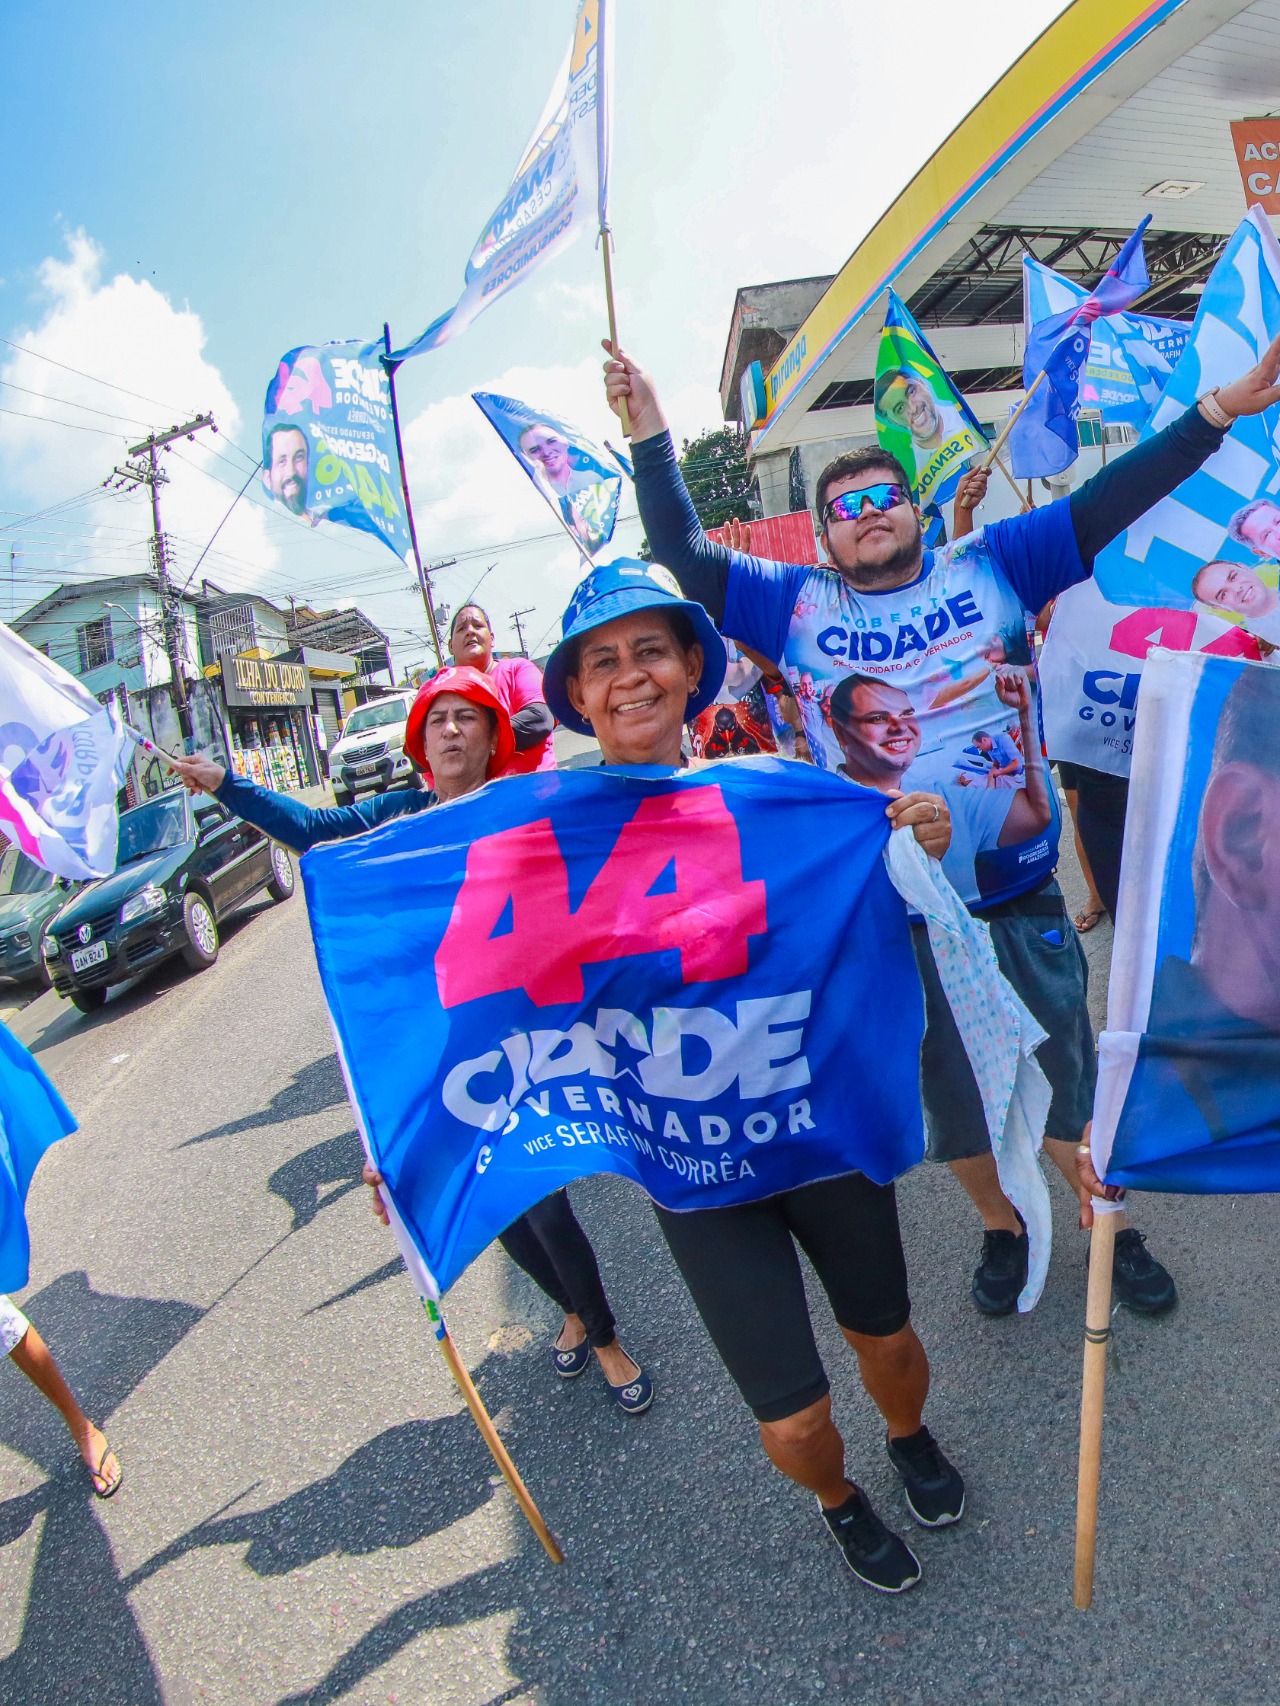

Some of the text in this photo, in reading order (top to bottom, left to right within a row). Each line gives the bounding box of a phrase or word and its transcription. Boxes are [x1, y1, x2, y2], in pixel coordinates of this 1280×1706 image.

[770, 334, 807, 401] Ipiranga
[816, 589, 984, 662] CIDADE
[913, 631, 974, 666] GVERNADOR
[434, 784, 768, 1009] 44
[441, 990, 812, 1132] CIDADE
[523, 1121, 757, 1186] VICE SERAFIM CORRÊA
